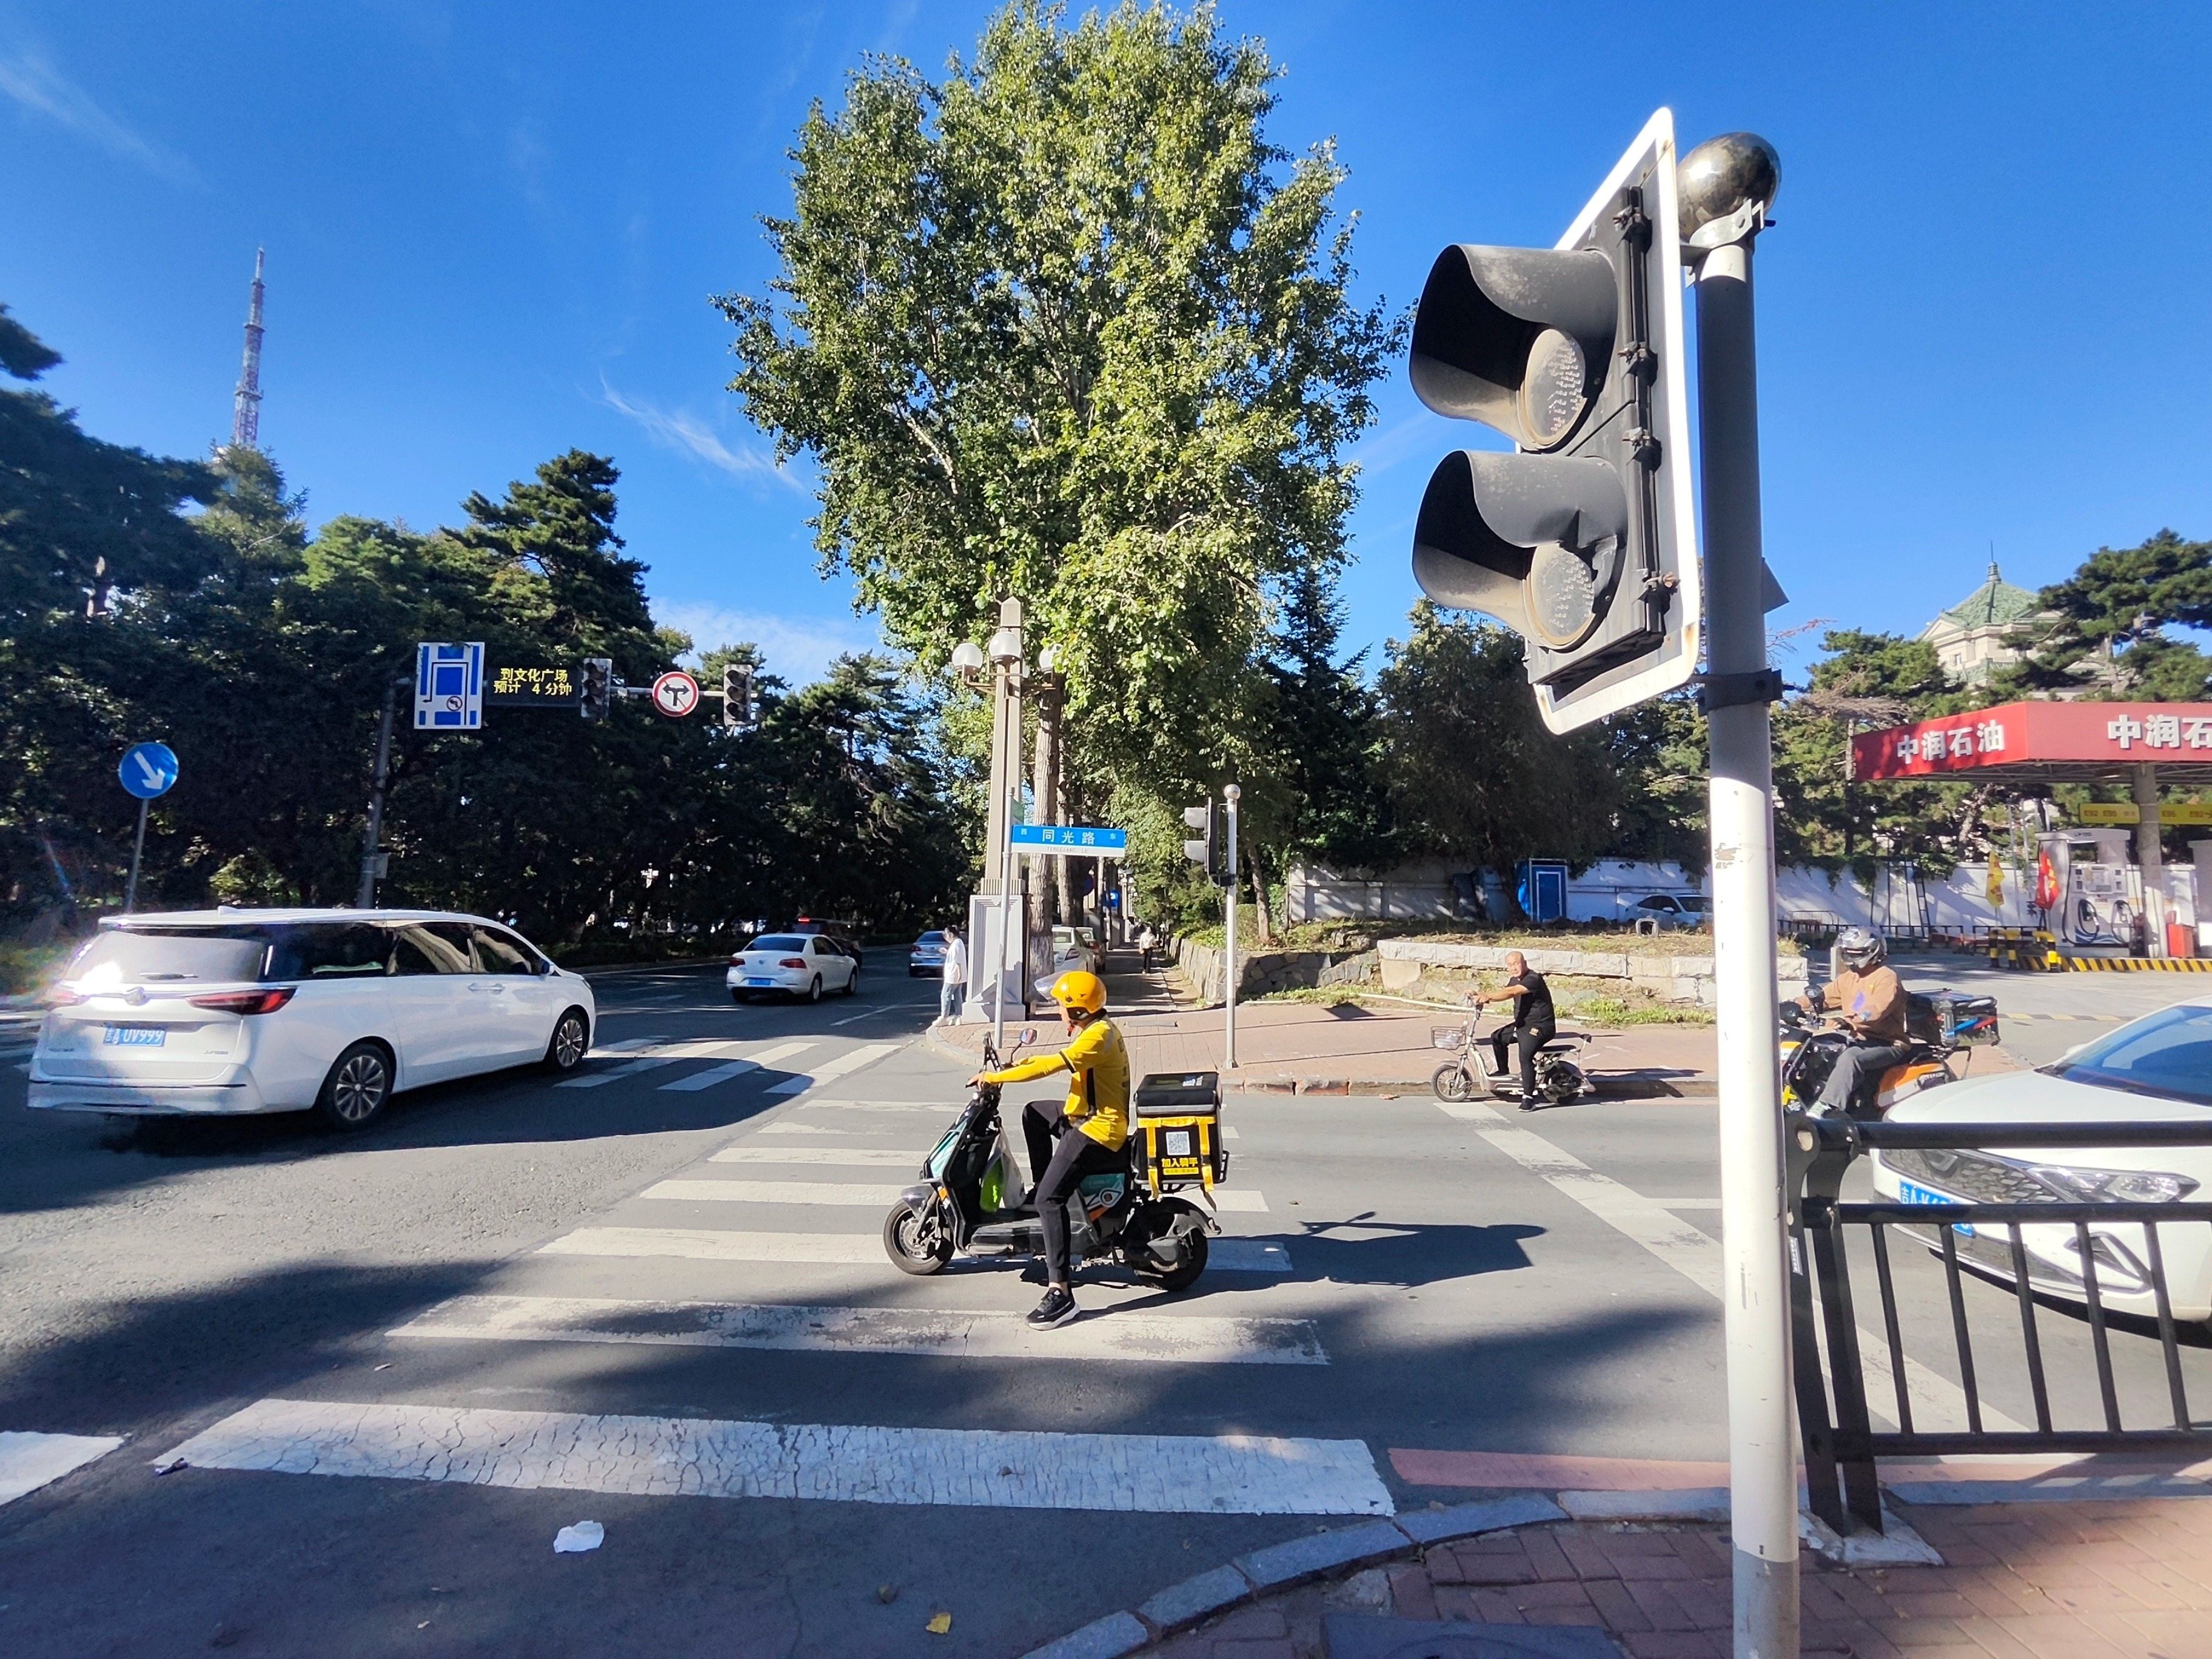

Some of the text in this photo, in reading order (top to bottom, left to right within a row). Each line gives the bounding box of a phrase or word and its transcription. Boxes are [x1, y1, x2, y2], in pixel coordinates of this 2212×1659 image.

[500, 668, 568, 682] 到文化广场
[493, 680, 572, 696] 预计 4 分钟
[2107, 714, 2212, 749] 中润石
[1897, 719, 2006, 765] 中润石油
[1042, 829, 1095, 845] 同光路
